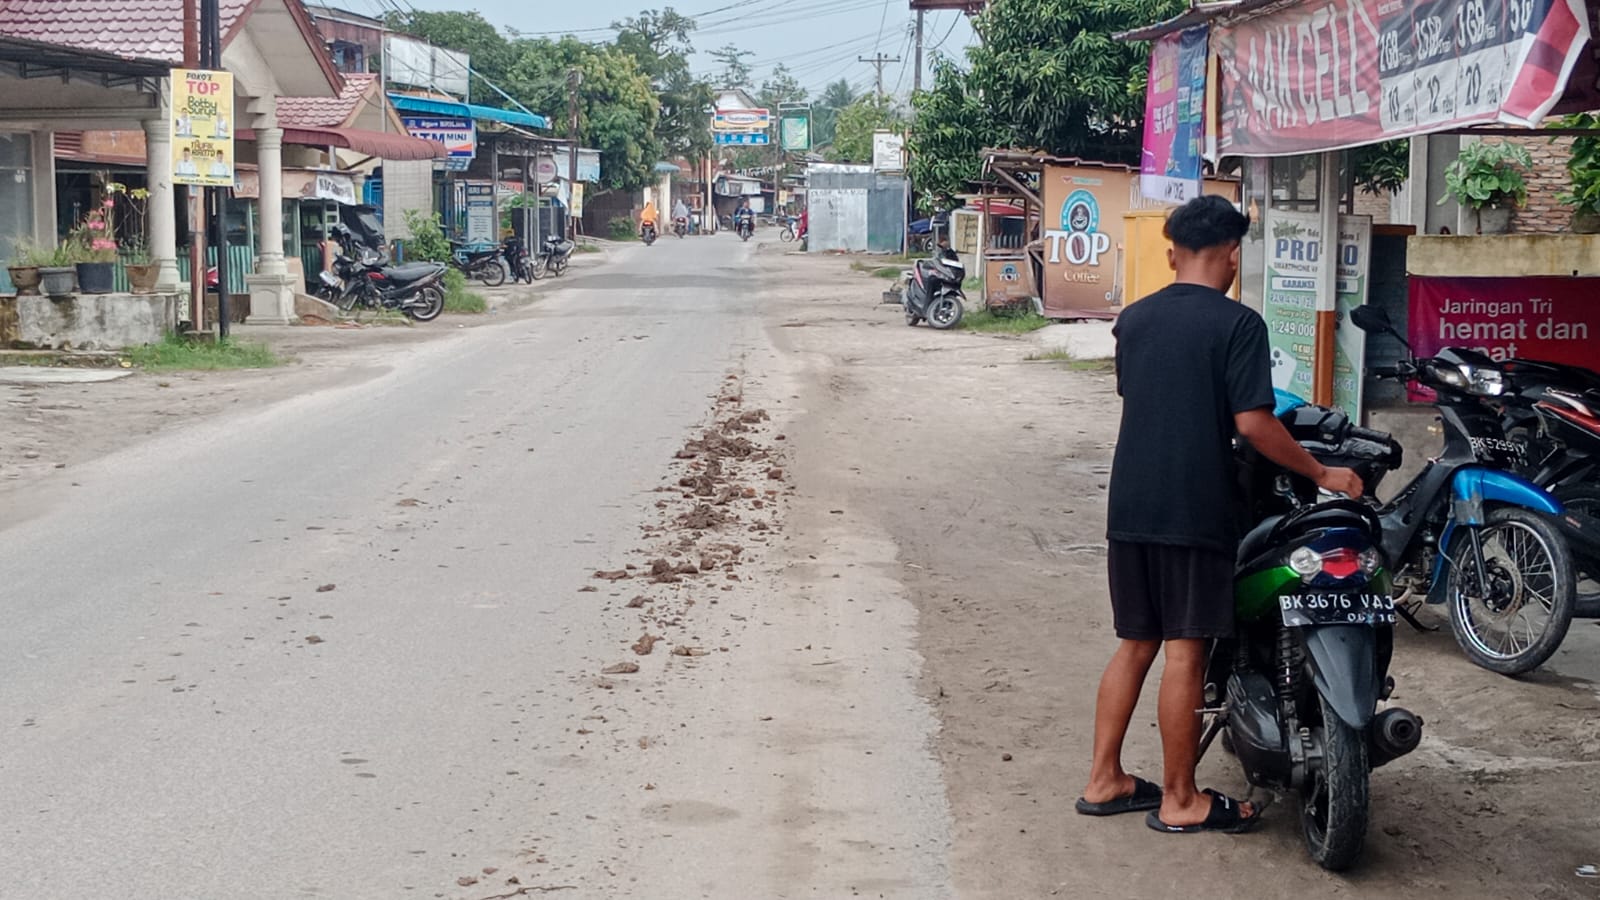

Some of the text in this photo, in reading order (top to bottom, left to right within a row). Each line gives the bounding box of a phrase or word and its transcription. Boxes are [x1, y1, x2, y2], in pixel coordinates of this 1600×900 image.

[186, 81, 220, 95] TOP
[1427, 75, 1440, 113] 12
[1465, 62, 1482, 106] 20
[446, 132, 467, 141] MINI
[1045, 229, 1110, 265] TOP
[1064, 269, 1100, 283] Coffee
[1439, 298, 1553, 318] Jaringan Tri
[1439, 317, 1588, 340] hemat dan
[1282, 594, 1395, 610] BK 3676 VAJ
